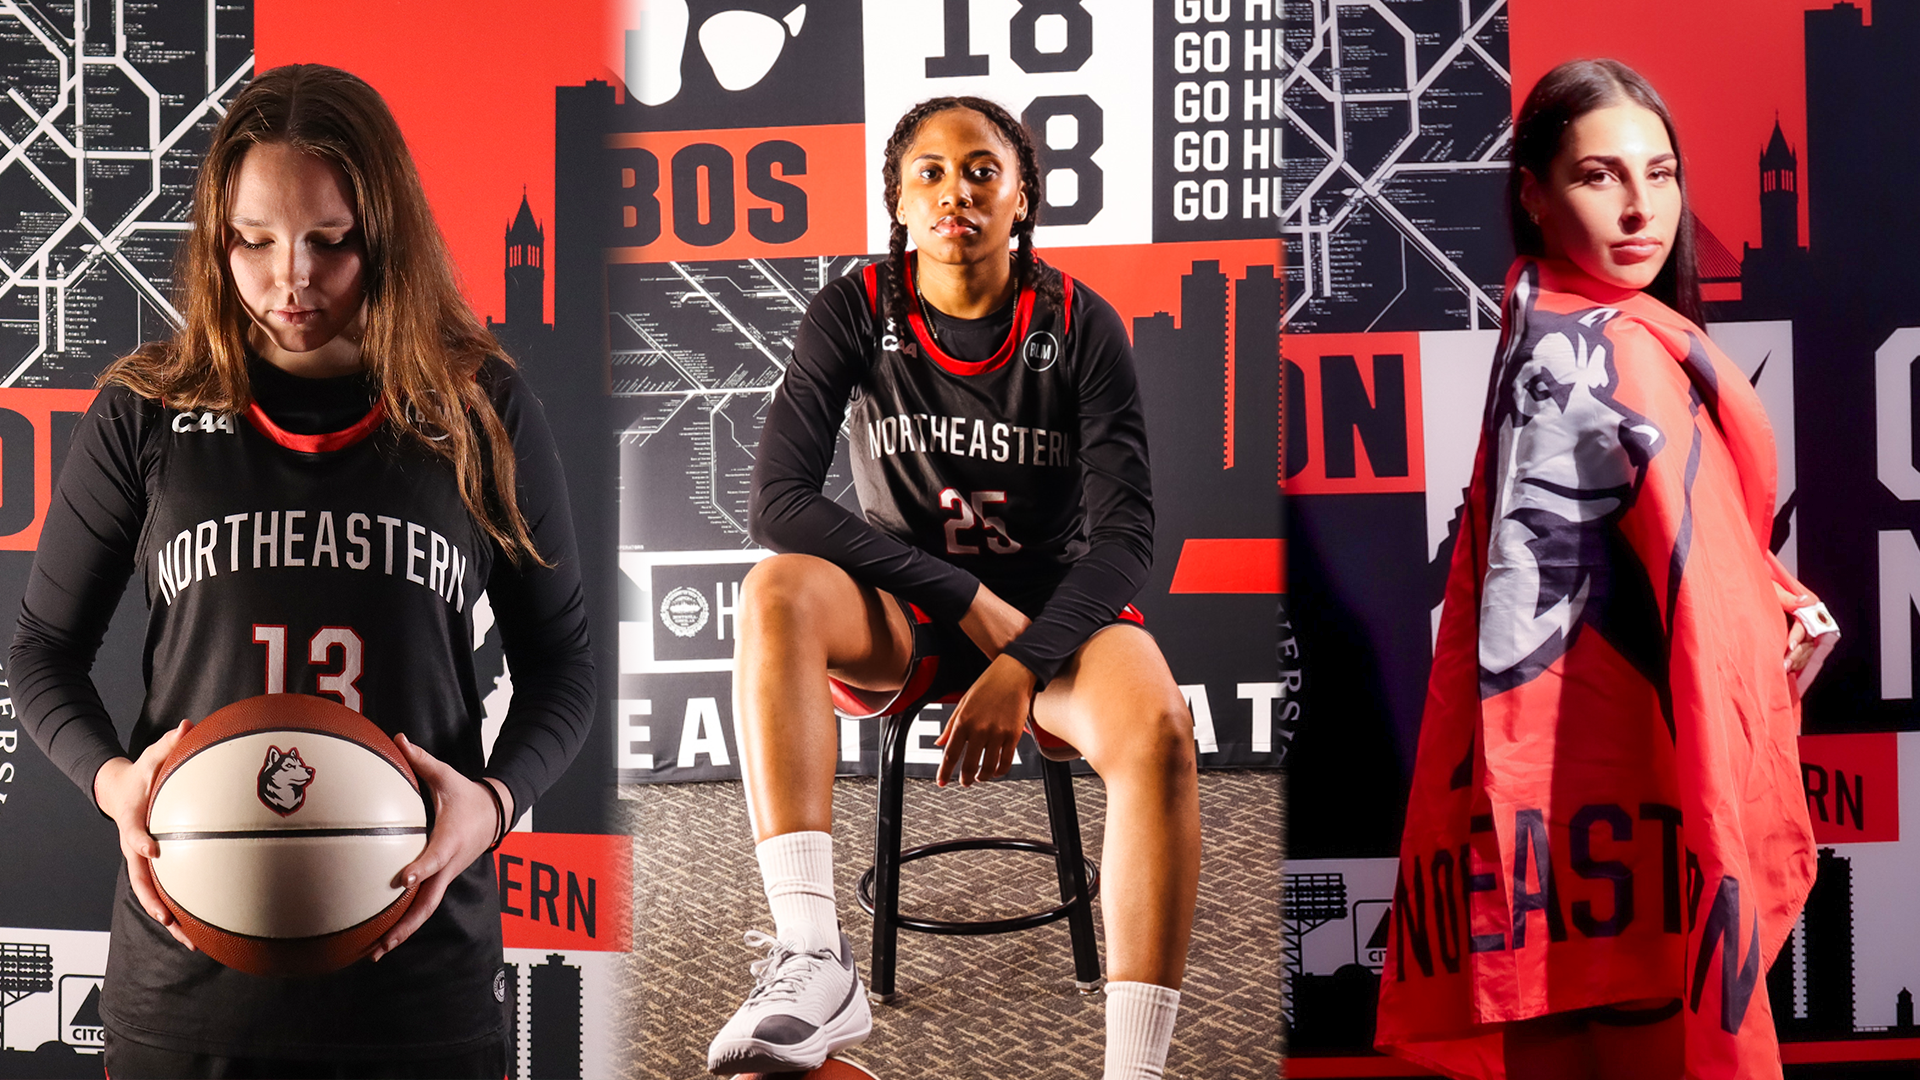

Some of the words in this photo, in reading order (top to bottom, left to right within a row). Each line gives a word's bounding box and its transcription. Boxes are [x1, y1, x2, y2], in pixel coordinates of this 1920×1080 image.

[1174, 30, 1231, 74] GO
[1174, 80, 1230, 124] GO
[1173, 130, 1230, 173] GO
[606, 140, 809, 248] BOS
[1173, 179, 1229, 222] GO
[171, 411, 235, 434] CAA
[938, 486, 1023, 555] 25
[157, 510, 467, 614] NORTHEASTERN
[252, 623, 365, 713] 13
[499, 853, 597, 939] ERN
